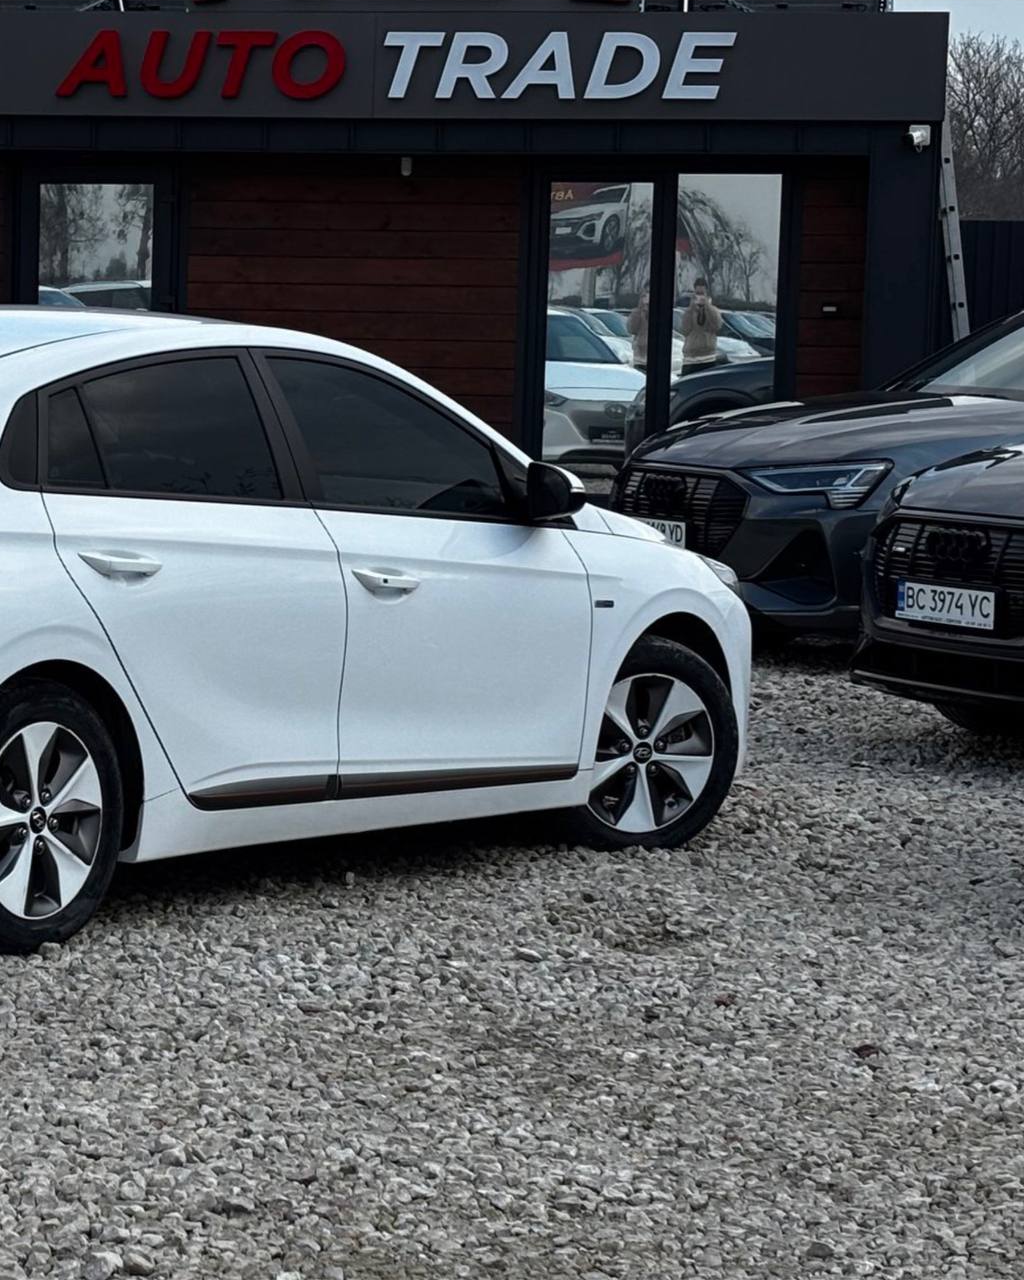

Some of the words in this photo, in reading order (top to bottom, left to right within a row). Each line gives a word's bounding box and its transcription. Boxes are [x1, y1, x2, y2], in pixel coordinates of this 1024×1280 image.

[55, 29, 347, 100] AUTO
[382, 30, 738, 101] TRADE
[906, 586, 926, 611] BC
[929, 589, 963, 617] 3974
[968, 593, 991, 619] YC
